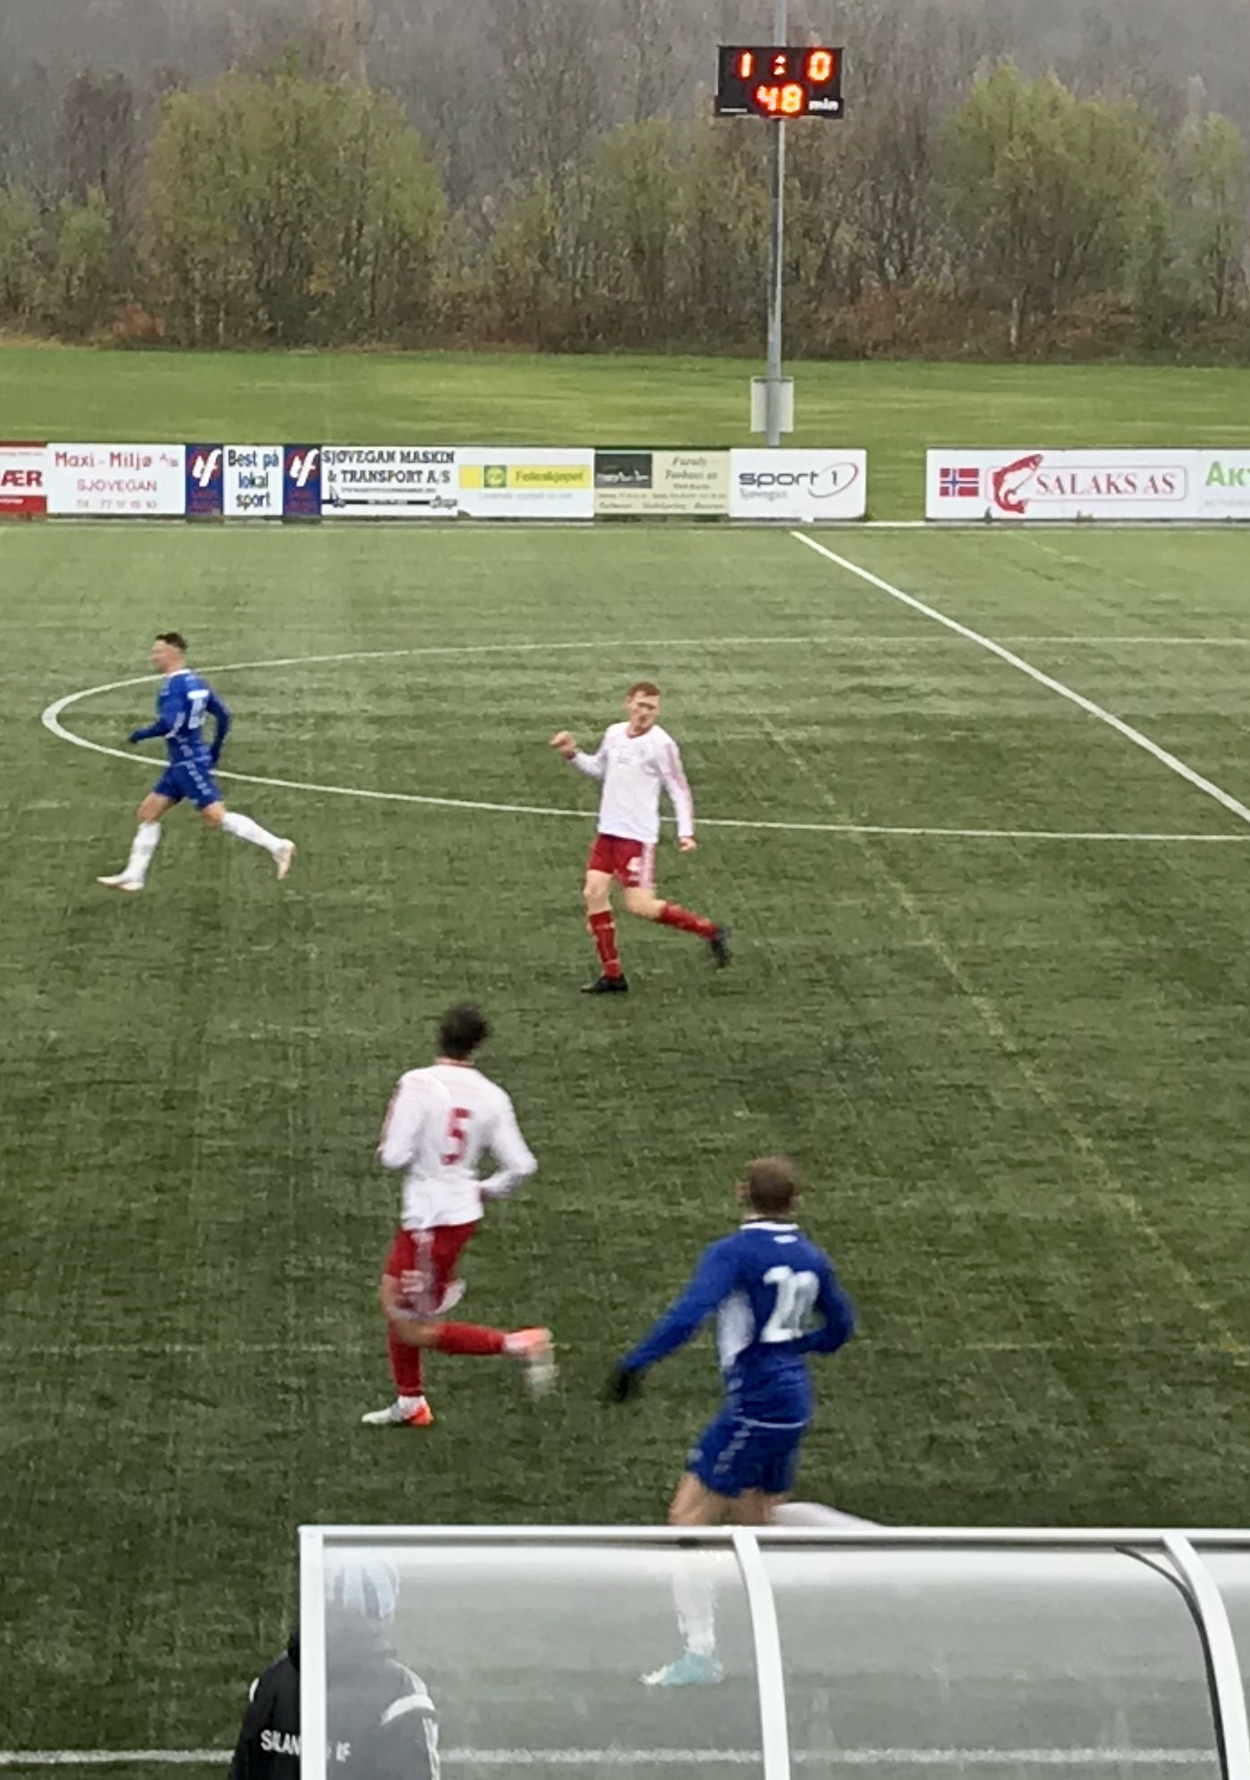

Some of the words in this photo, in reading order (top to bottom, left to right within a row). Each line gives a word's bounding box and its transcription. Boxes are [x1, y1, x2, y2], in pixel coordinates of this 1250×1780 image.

[740, 51, 753, 77] 1
[807, 51, 832, 80] 0
[756, 84, 803, 113] 48
[809, 98, 839, 111] min
[228, 449, 257, 467] Best
[263, 450, 279, 470] på
[322, 450, 395, 465] SJØVEGAN
[399, 450, 455, 464] MASKIN
[238, 472, 269, 489] lokal
[327, 470, 337, 482] &
[340, 470, 422, 483] TRANSPORT
[426, 470, 450, 483] A/S
[738, 471, 819, 488] sport
[831, 470, 838, 485] 1
[1037, 473, 1137, 495] SALAKS
[1145, 473, 1175, 495] AS
[236, 492, 270, 510] sport
[440, 1107, 472, 1165] 5
